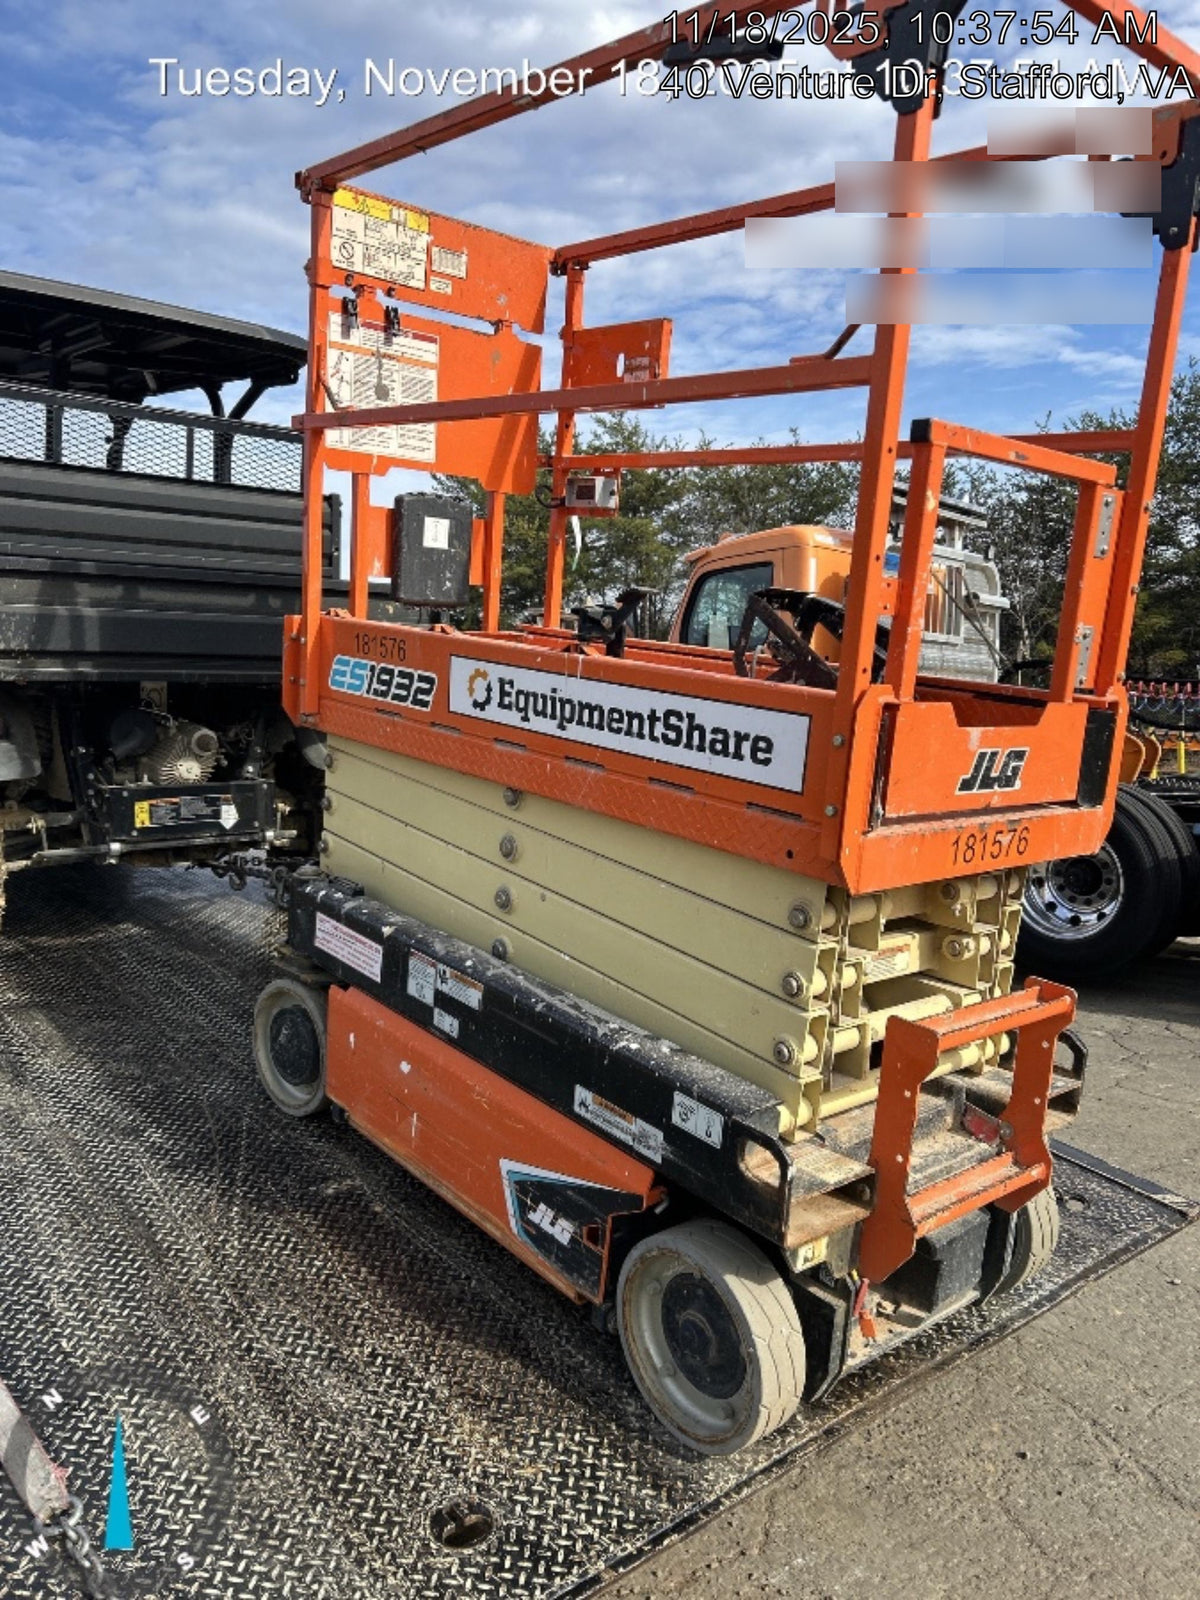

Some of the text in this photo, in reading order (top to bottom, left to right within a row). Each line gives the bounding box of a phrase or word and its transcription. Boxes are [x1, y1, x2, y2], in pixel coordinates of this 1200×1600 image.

[354, 632, 406, 661] 181576
[329, 654, 438, 711] ES1932
[497, 676, 774, 767] EquipmentShare
[955, 747, 1030, 795] JLG
[951, 826, 1030, 866] 181576
